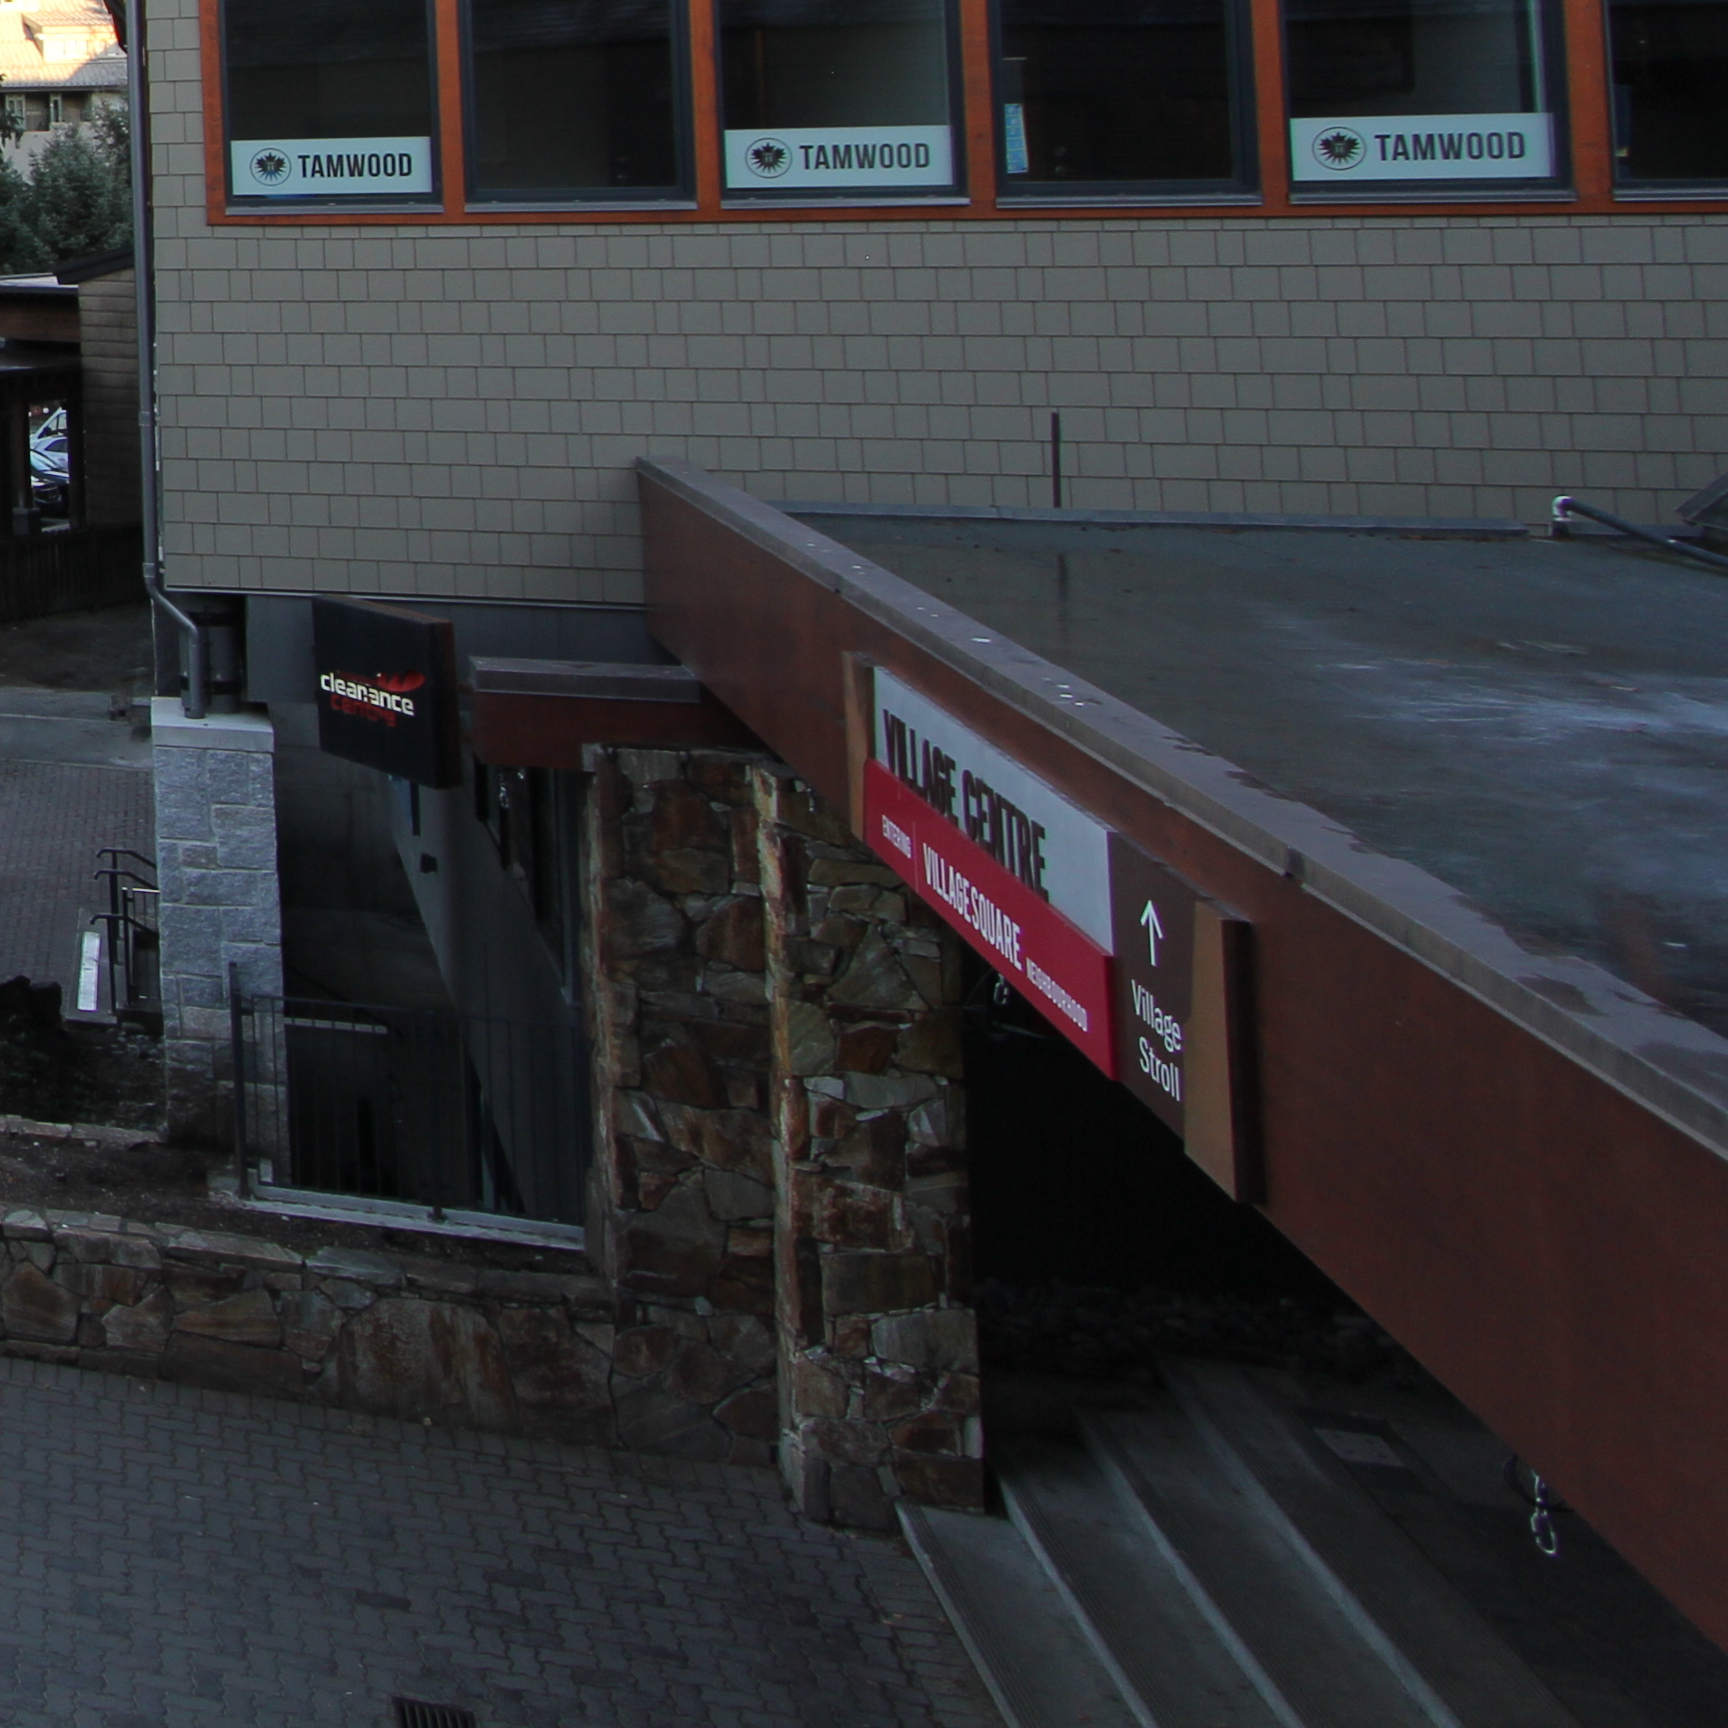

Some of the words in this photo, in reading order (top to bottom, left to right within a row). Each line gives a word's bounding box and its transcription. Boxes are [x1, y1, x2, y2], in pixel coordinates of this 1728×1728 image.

[297, 153, 412, 178] TAMWOOD
[799, 143, 930, 170] TAMWOOD
[1375, 132, 1525, 161] TAMWOOD
[320, 672, 415, 717] clearance
[883, 708, 959, 829] VILLAGE
[962, 769, 1050, 903] CENTRE
[882, 814, 912, 859] ENTERING
[1026, 957, 1089, 1032] NEIGHBOURHOOD
[1131, 979, 1182, 1053] Village
[1138, 1036, 1181, 1102] Stroll
